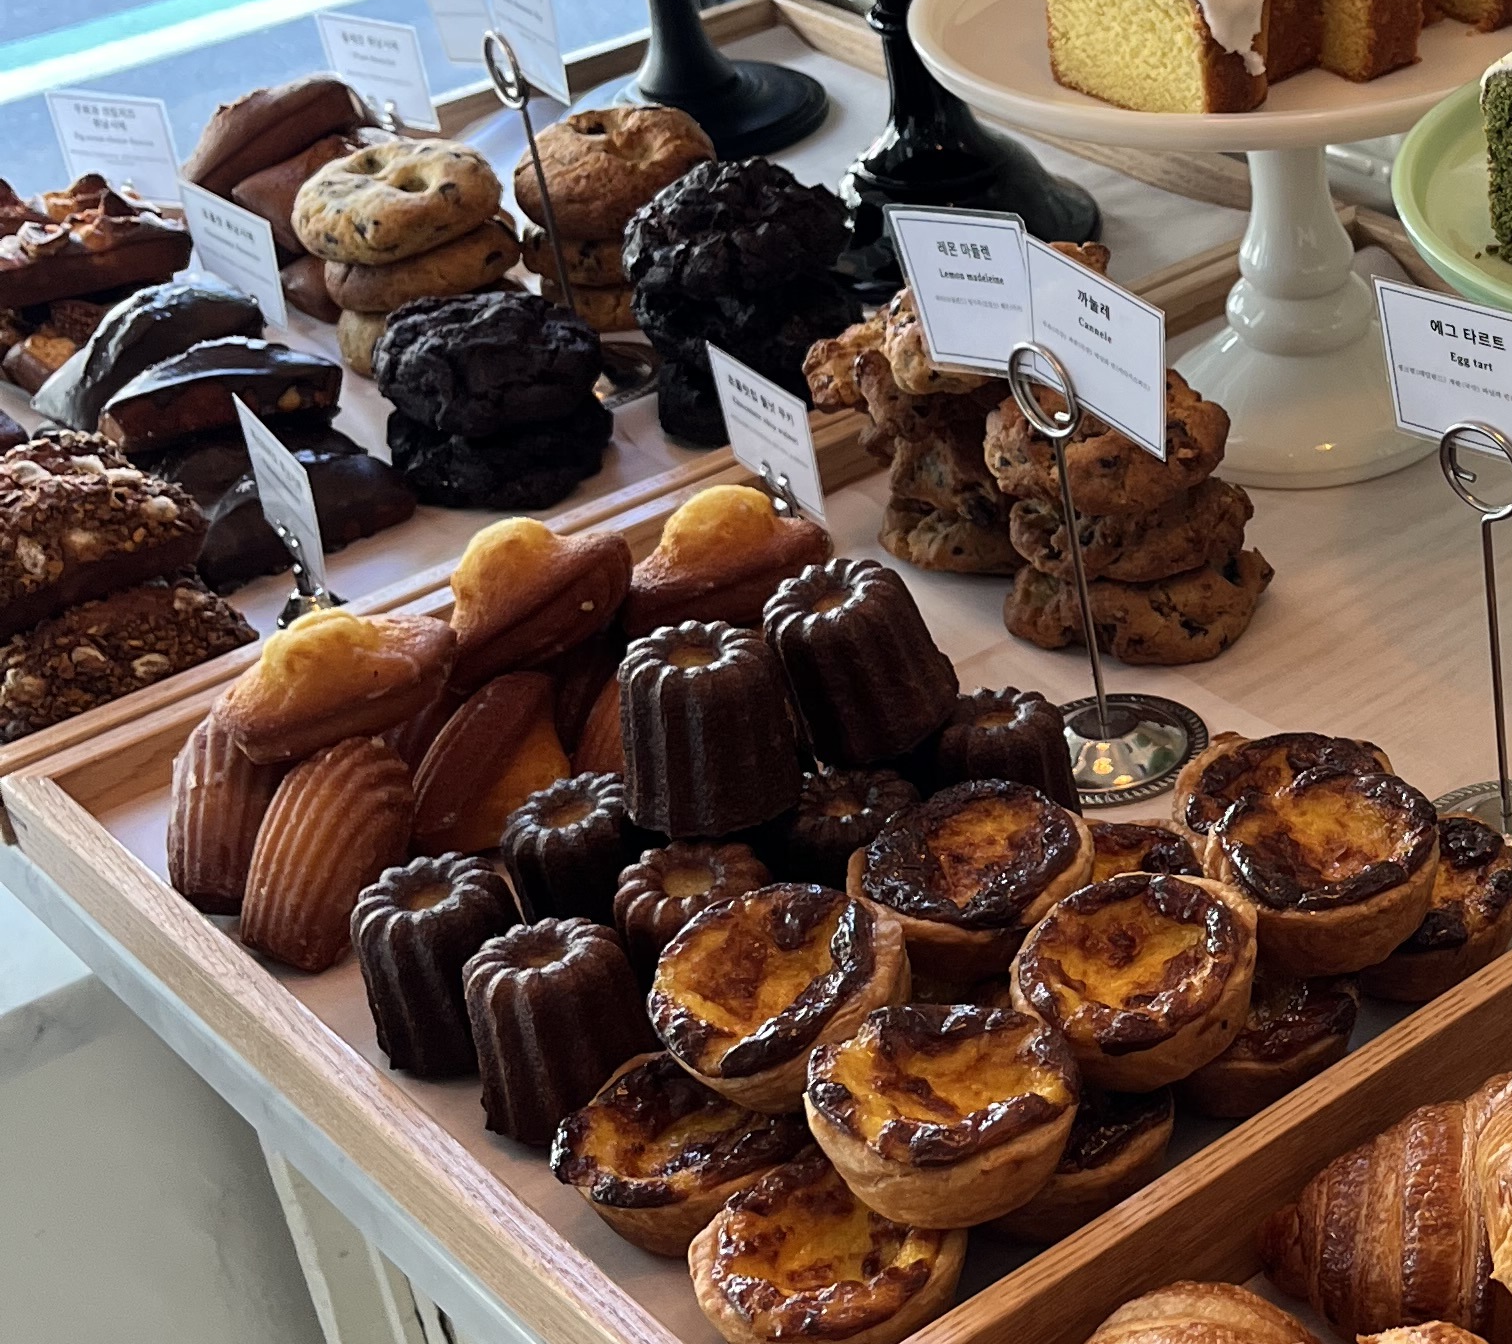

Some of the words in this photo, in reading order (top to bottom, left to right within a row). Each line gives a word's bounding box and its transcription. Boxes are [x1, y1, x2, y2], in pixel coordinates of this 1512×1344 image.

[936, 240, 958, 257] 레몬
[960, 243, 991, 260] 마들렌
[939, 269, 965, 279] Lemon
[966, 272, 1004, 285] madeleine
[1078, 289, 1110, 321] 까눌레
[1078, 316, 1111, 344] Cannele
[1430, 319, 1458, 339] 에그
[1463, 327, 1505, 352] 타르트
[1450, 352, 1470, 368] Egg
[1473, 359, 1492, 371] tart
